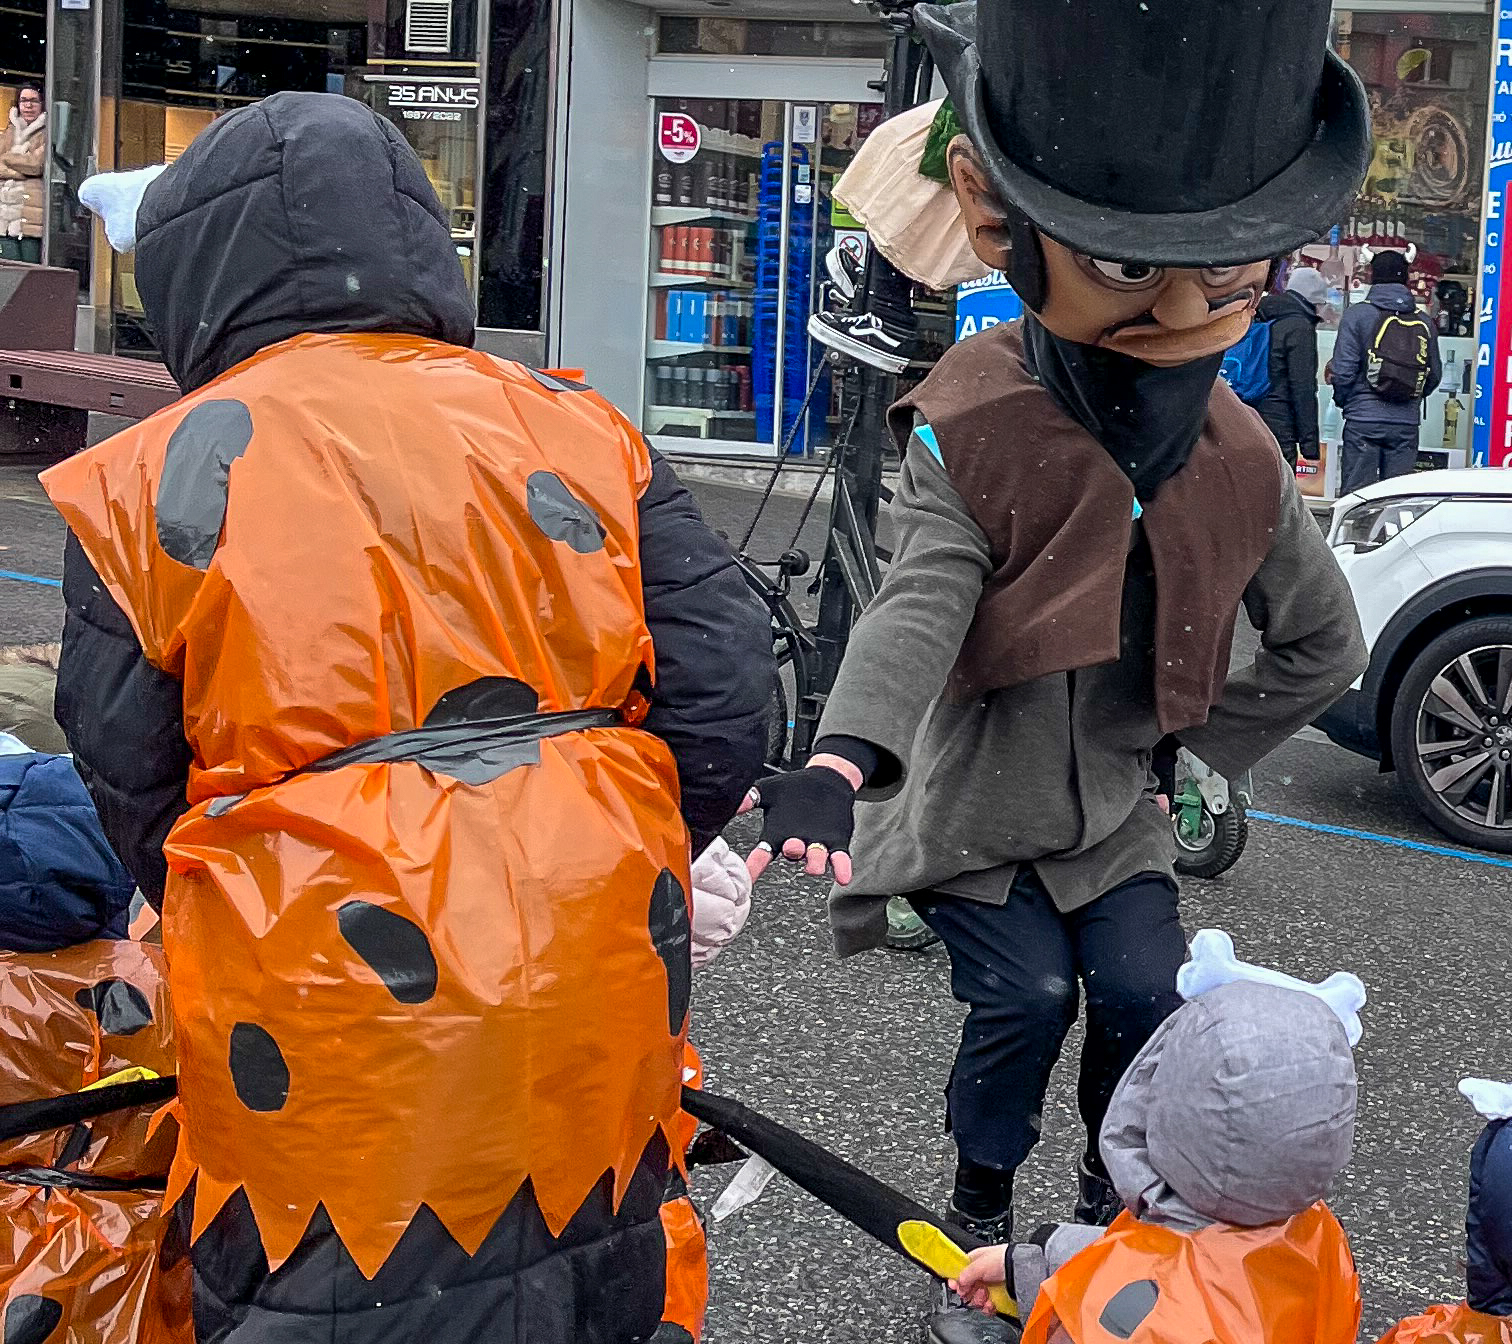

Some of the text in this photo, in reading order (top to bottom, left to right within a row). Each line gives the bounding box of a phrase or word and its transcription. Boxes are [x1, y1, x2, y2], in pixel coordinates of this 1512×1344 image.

[388, 84, 480, 109] 35 ANYS
[664, 119, 695, 144] -5%
